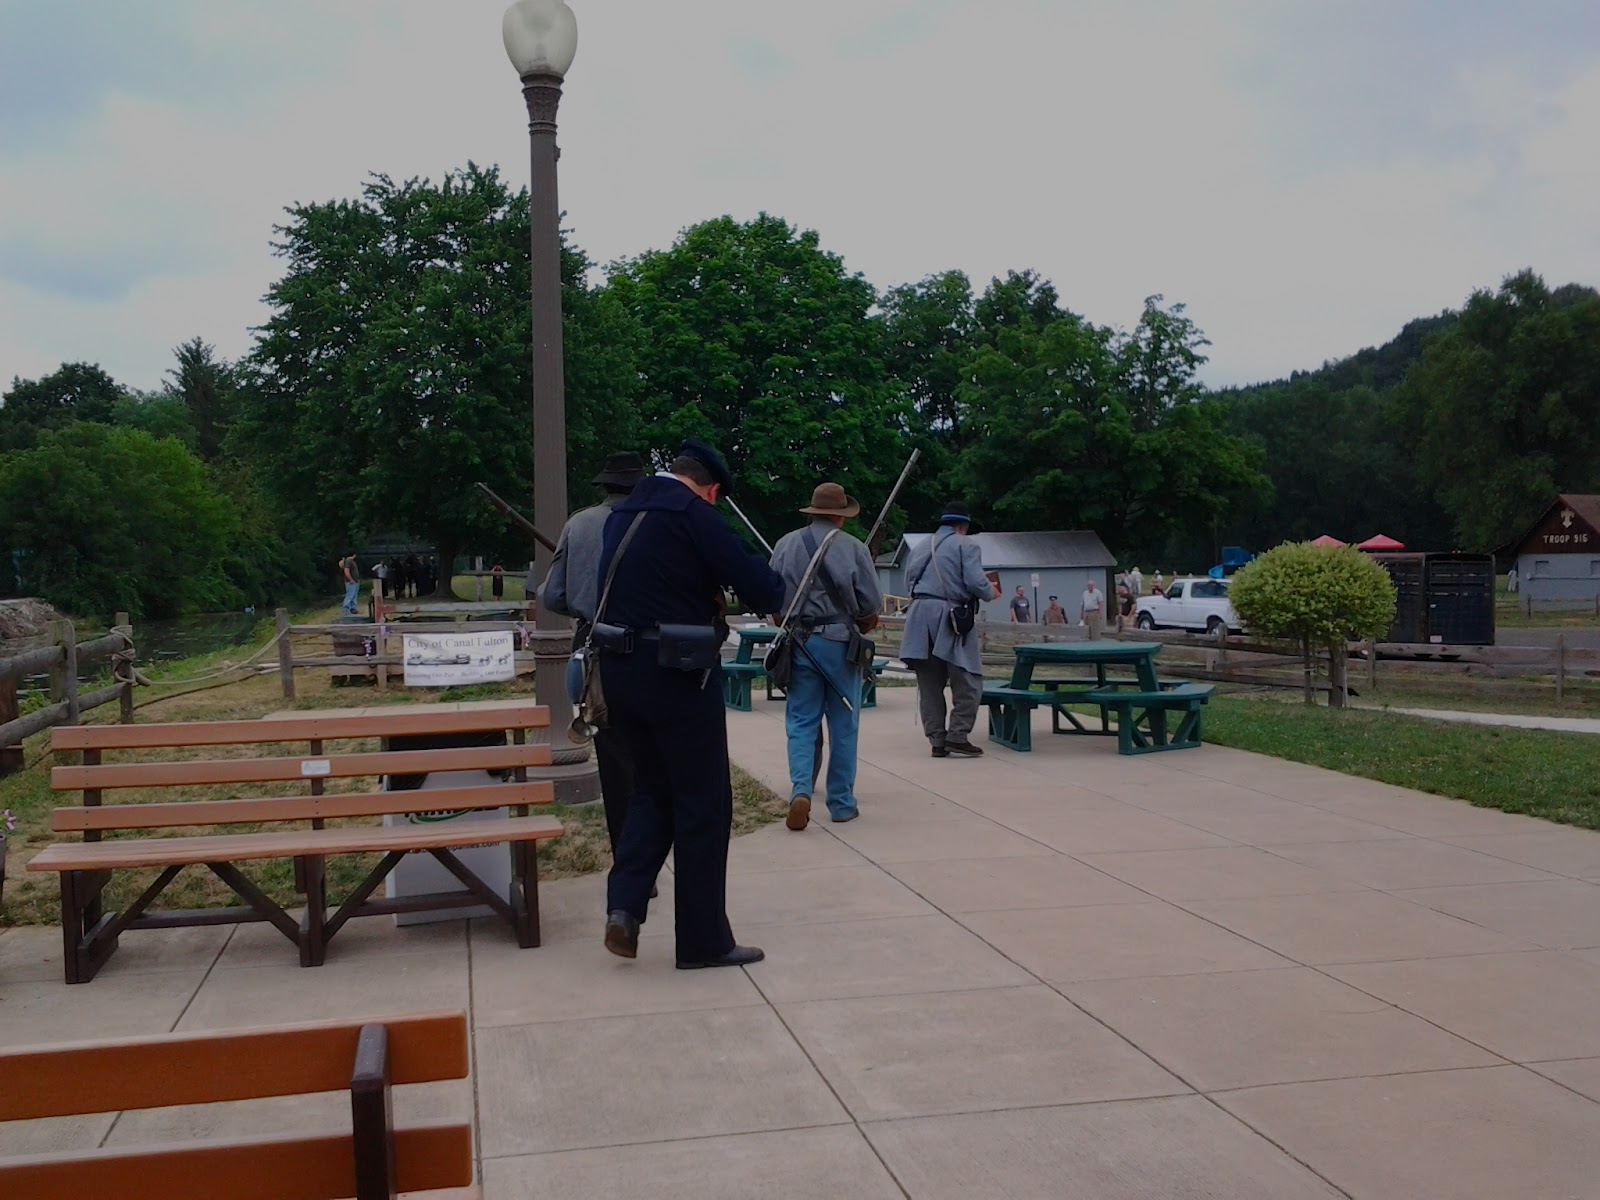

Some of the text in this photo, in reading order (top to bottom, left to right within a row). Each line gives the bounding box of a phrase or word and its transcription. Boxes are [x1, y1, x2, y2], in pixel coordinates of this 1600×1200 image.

[1543, 533, 1588, 544] TROOP 916
[408, 636, 509, 650] City of Canal Fulton
